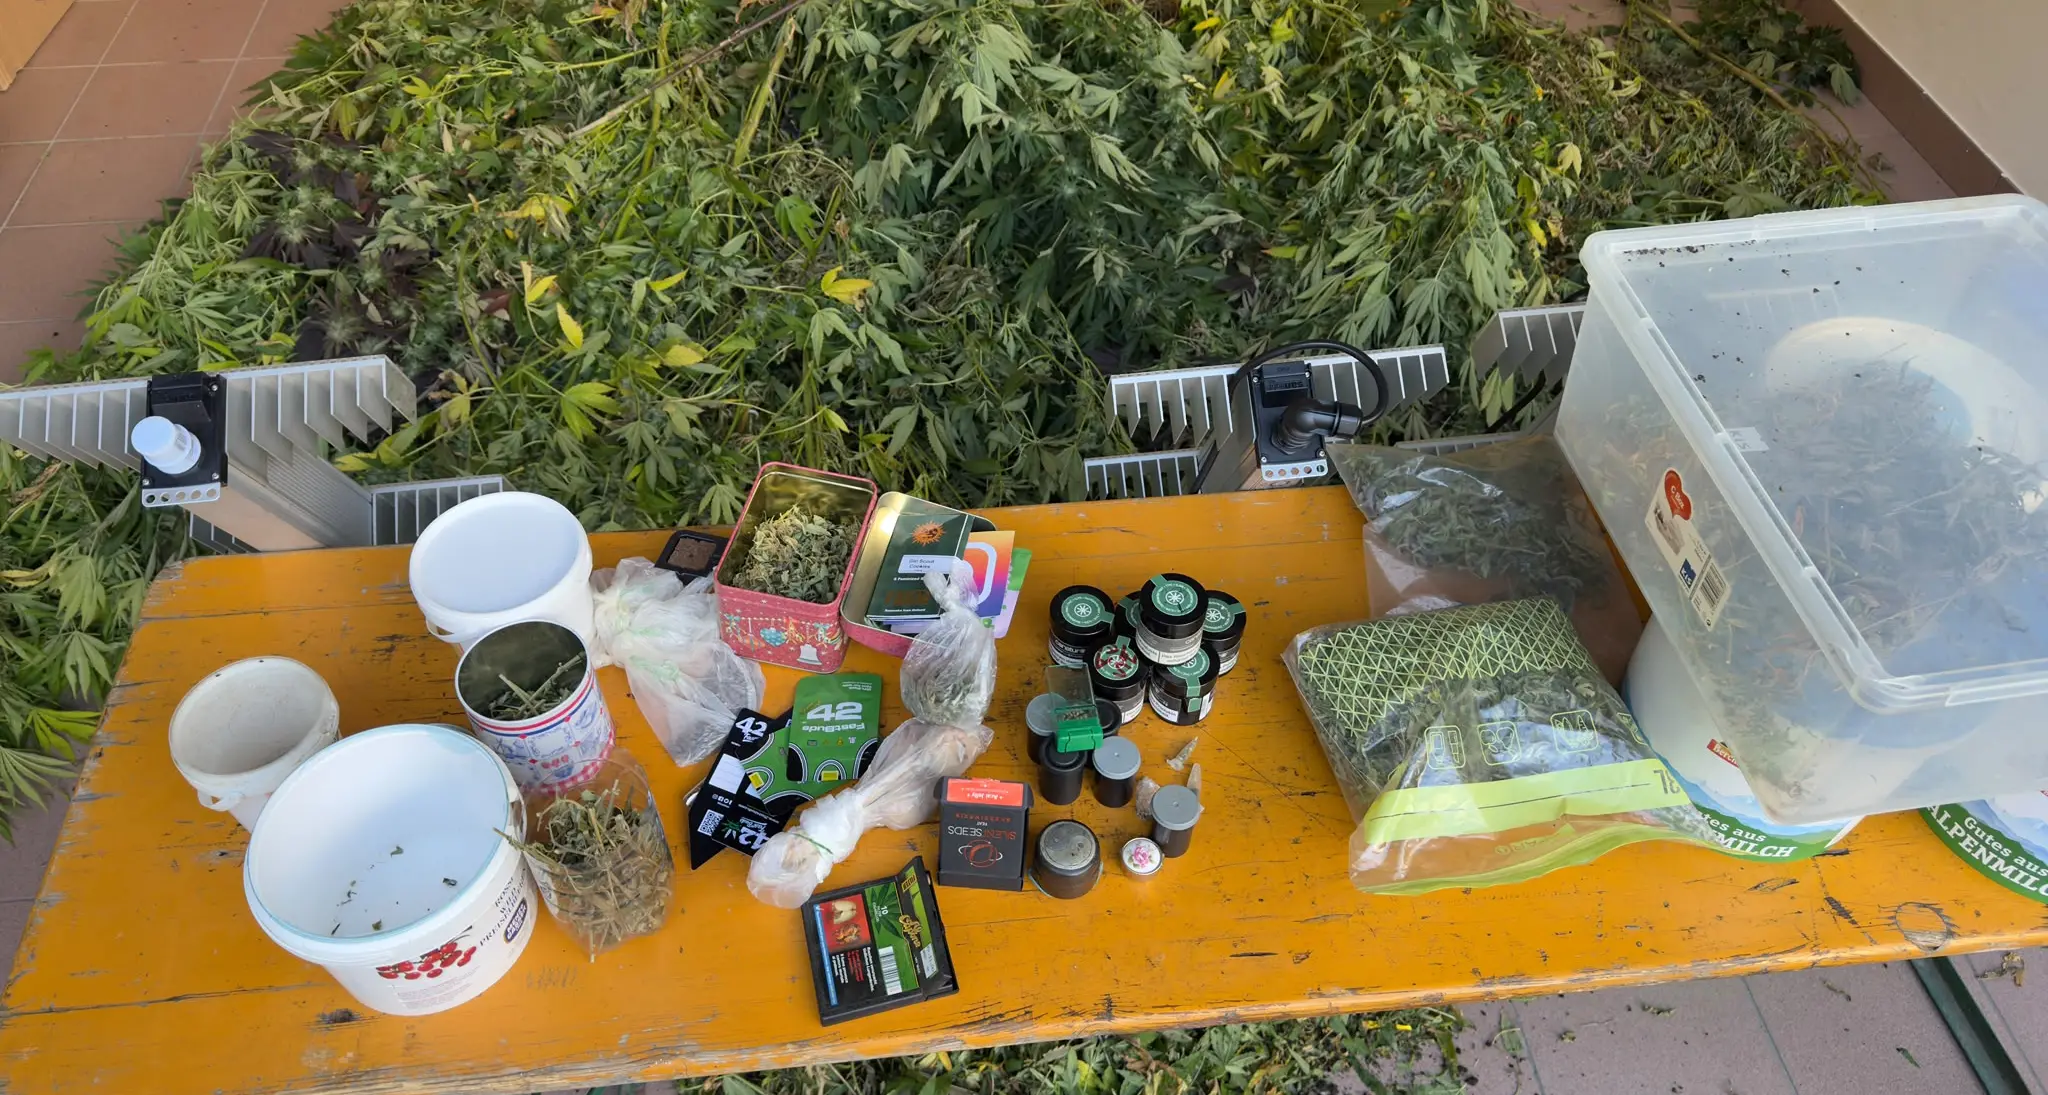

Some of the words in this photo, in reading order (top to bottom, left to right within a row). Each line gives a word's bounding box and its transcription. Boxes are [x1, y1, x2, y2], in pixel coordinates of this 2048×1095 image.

[806, 701, 863, 722] 42
[735, 716, 768, 738] 42
[802, 722, 866, 733] FastBuds
[738, 826, 770, 850] 42
[947, 825, 983, 837] SEEDS
[1702, 813, 1730, 832] tes
[1732, 828, 1768, 842] aus
[1963, 816, 2013, 857] Gutes
[2013, 855, 2048, 877] aus
[880, 905, 889, 915] 10
